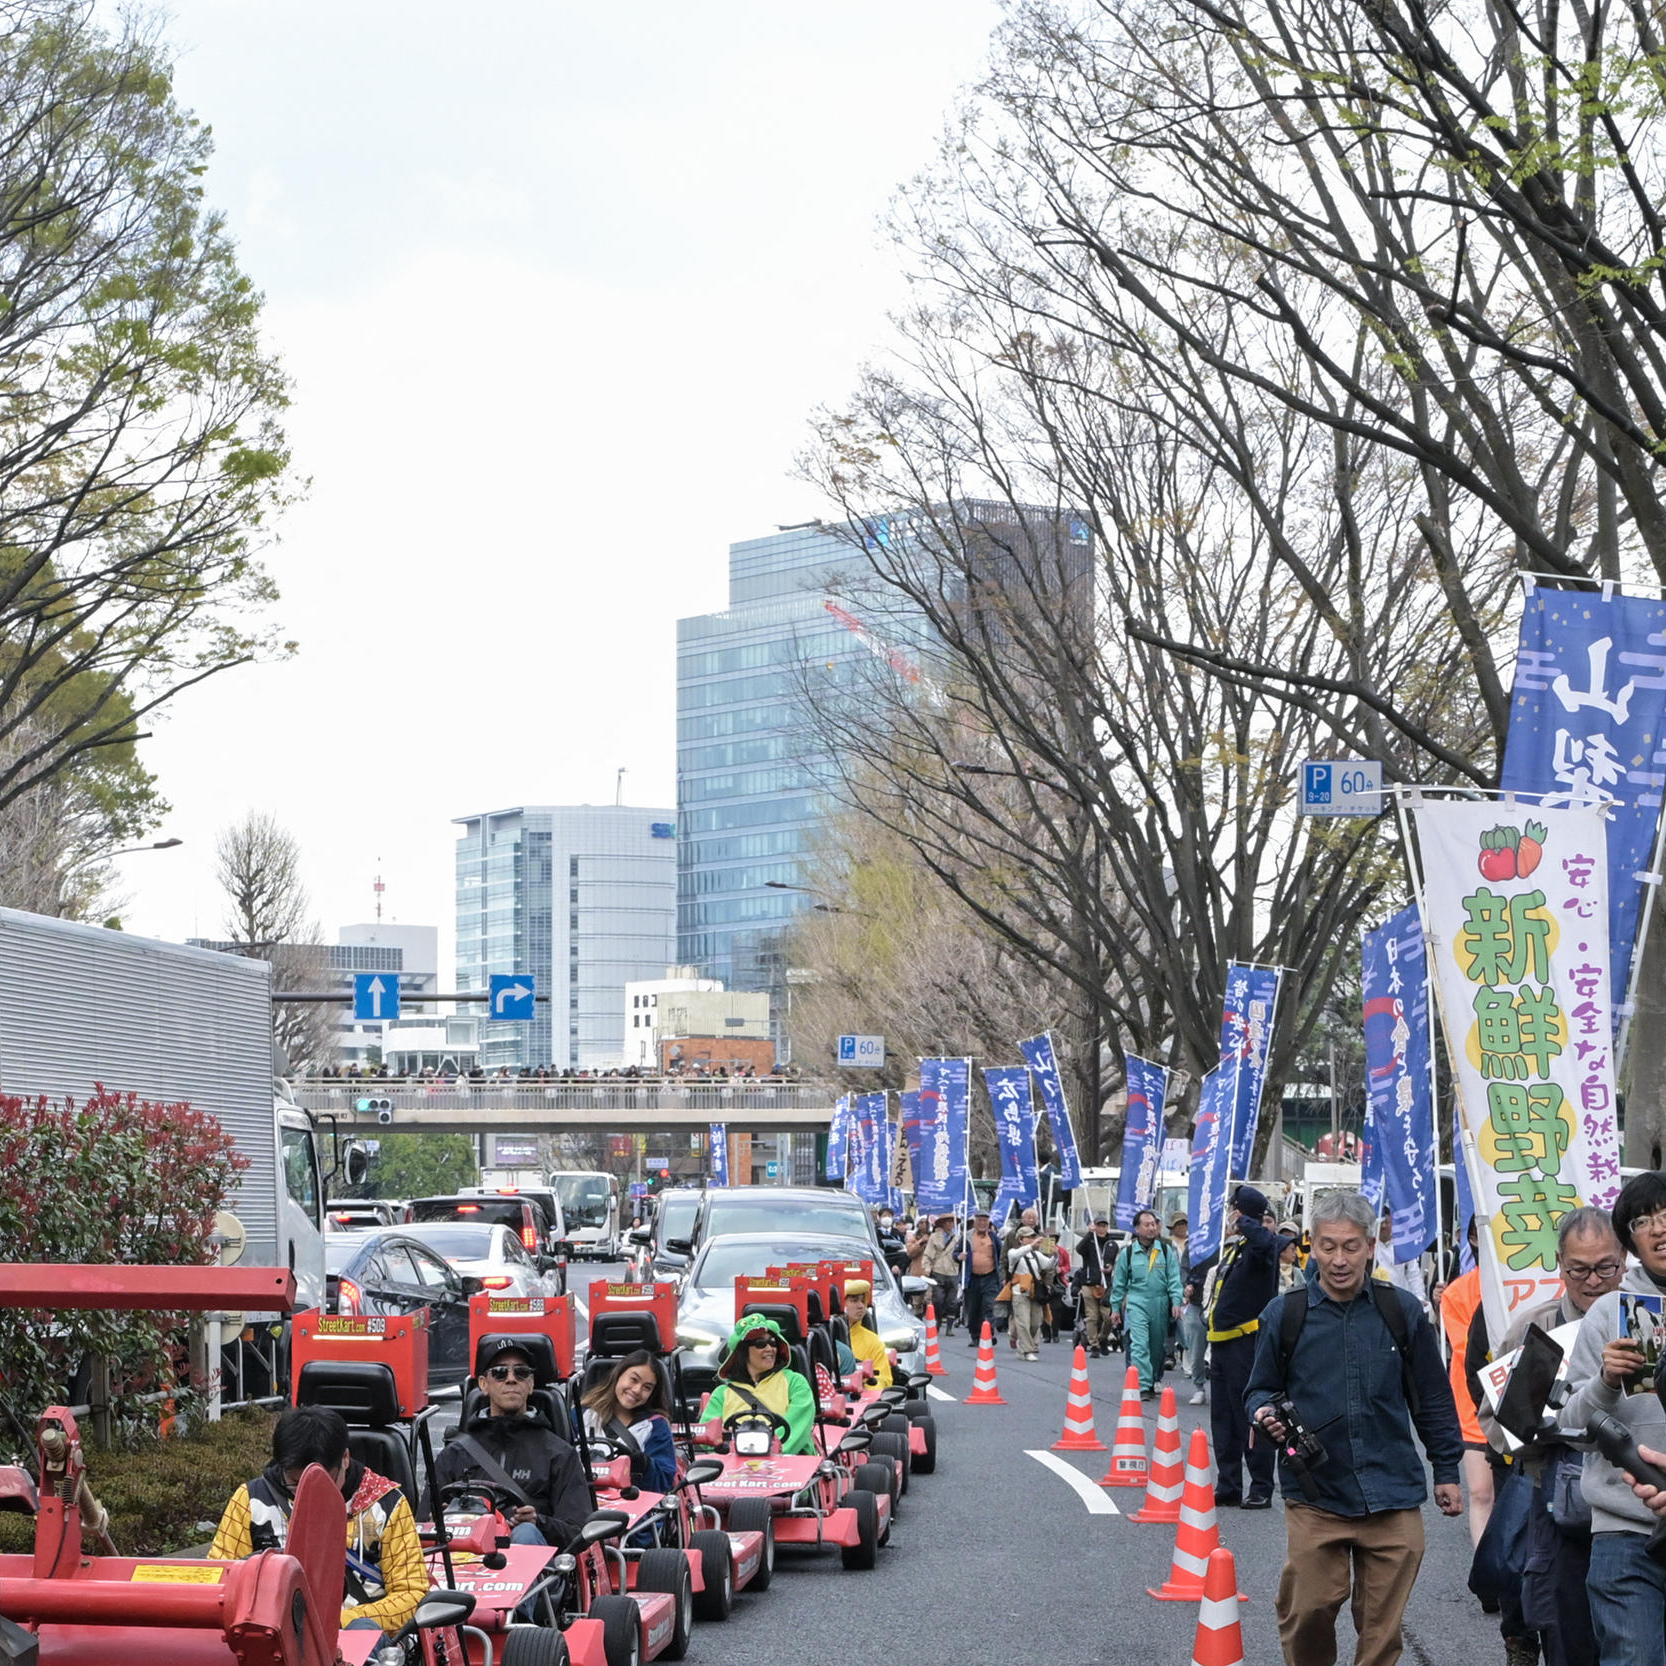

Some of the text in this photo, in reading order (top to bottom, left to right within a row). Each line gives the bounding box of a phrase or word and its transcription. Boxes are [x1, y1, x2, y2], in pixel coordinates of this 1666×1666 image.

[1313, 767, 1327, 790] P
[844, 1038, 853, 1051] P
[1462, 886, 1577, 1272] 新鮮野菜
[512, 1469, 531, 1480] HH
